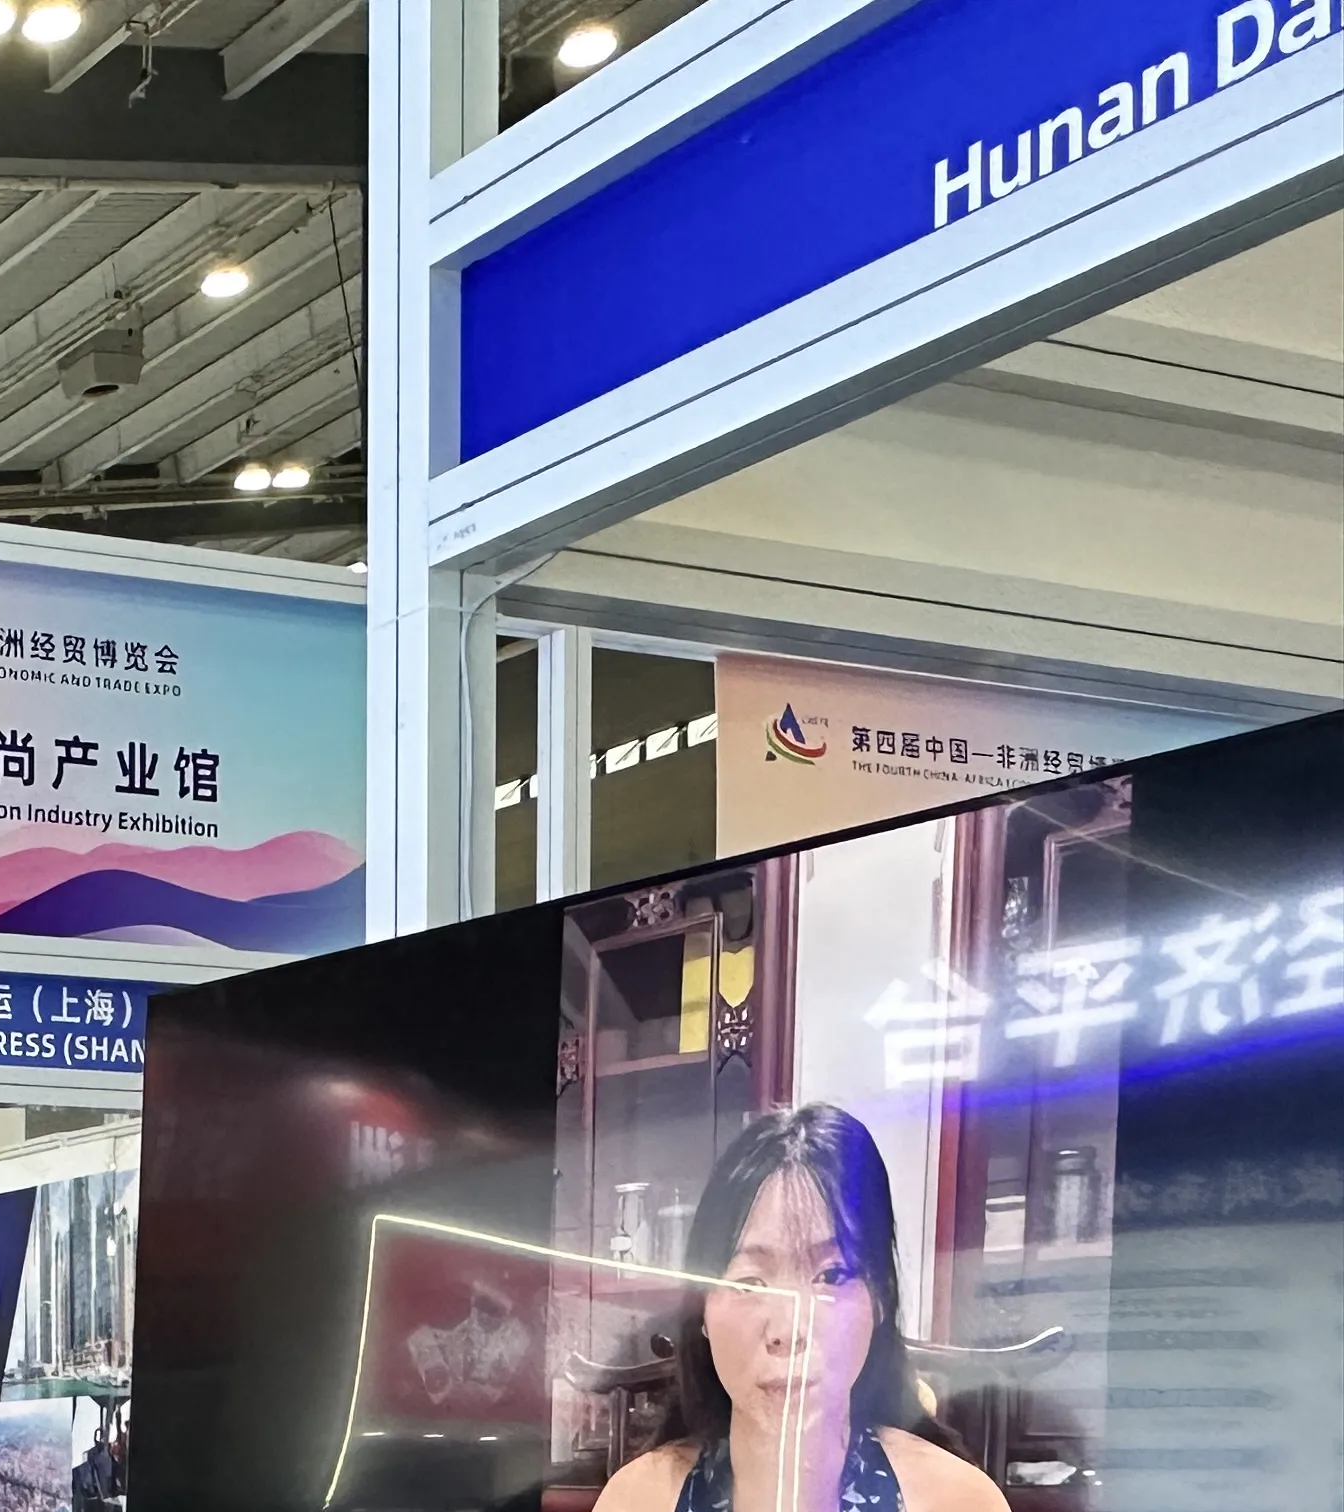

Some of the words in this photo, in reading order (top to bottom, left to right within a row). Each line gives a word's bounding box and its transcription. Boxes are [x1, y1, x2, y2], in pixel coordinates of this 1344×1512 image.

[933, 51, 1190, 229] Hunan
[1216, 0, 1344, 89] Da
[60, 673, 91, 688] AND
[95, 676, 141, 694] TRADE
[144, 682, 182, 697] EXPO
[27, 803, 112, 833] Industry
[117, 811, 219, 838] Exhibition
